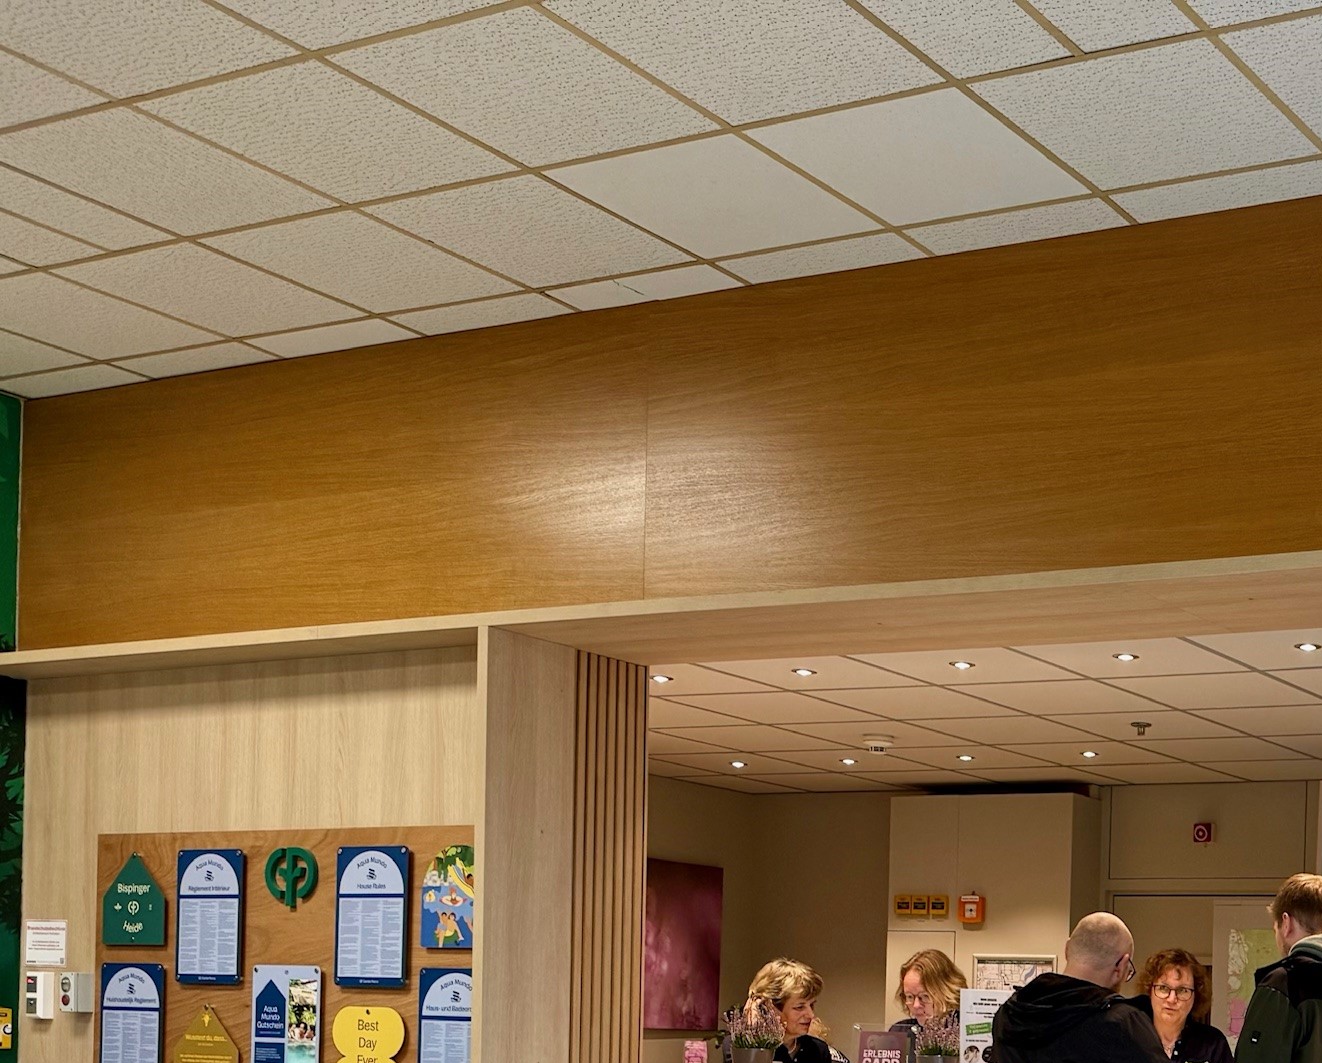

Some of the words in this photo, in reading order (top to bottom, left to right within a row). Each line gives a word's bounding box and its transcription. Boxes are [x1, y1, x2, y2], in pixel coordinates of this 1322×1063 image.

[357, 858, 370, 869] Aqua
[370, 856, 387, 868] Mundo
[117, 883, 150, 896] Bispinger
[122, 920, 144, 933] Heide
[440, 980, 454, 990] Aqua
[454, 979, 472, 991] Mundo
[263, 1005, 278, 1014] Aqua
[256, 1021, 284, 1029] Gutschein
[357, 1019, 379, 1032] Best
[358, 1037, 377, 1052] Day
[863, 1049, 901, 1058] ERLEBNIS
